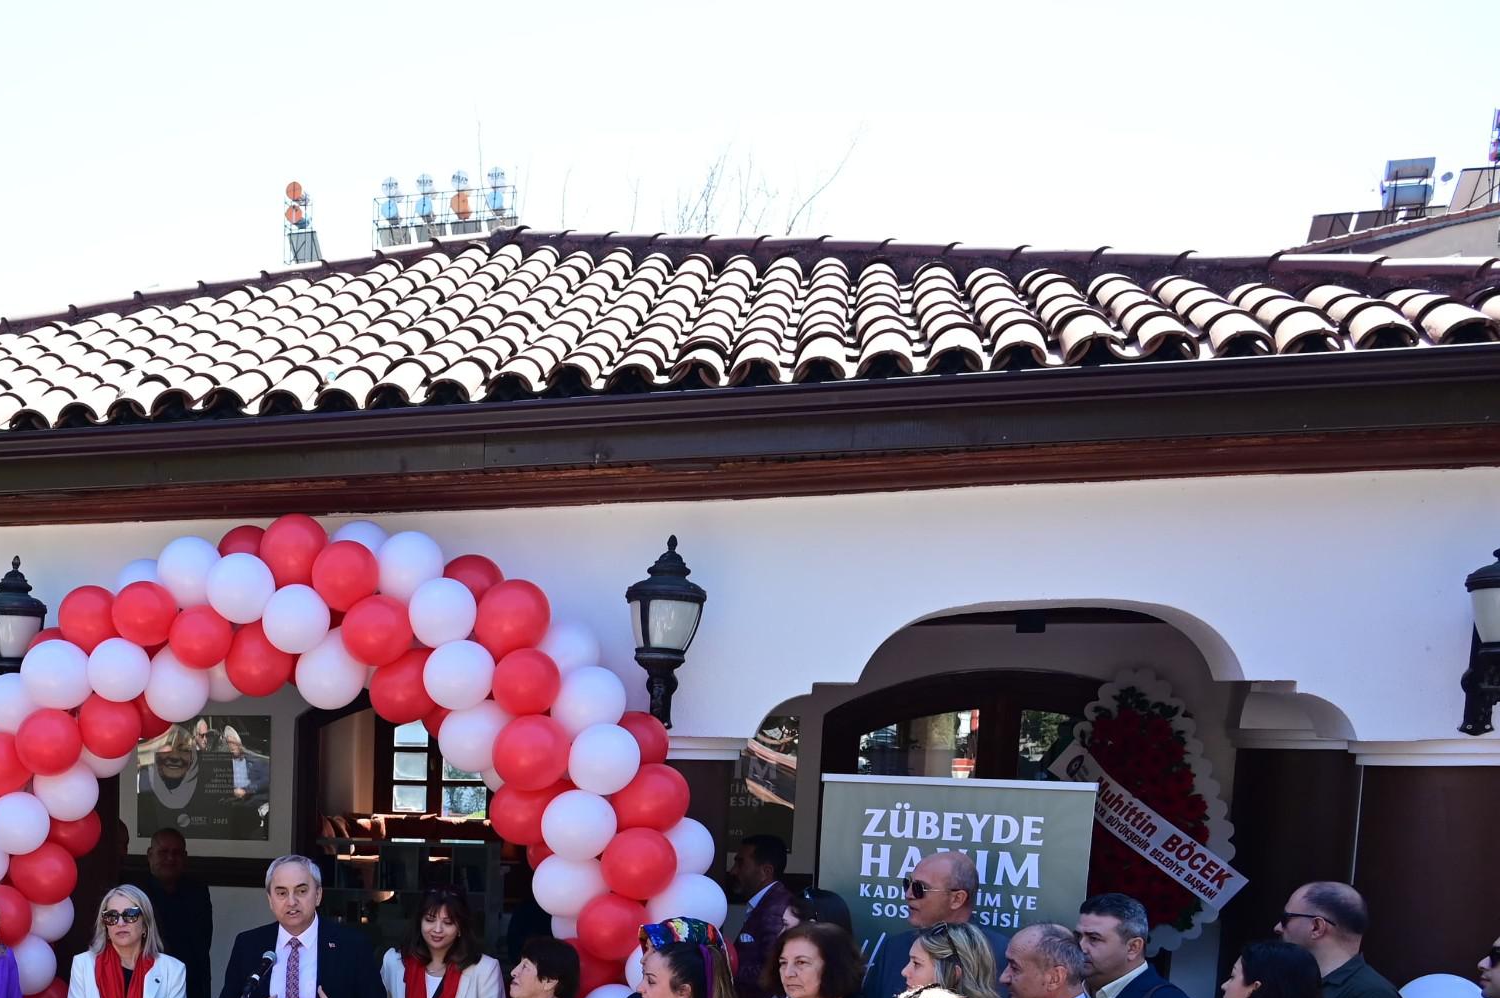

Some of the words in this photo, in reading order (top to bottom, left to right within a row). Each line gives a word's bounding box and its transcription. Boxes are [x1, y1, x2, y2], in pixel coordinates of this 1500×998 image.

[861, 802, 1045, 846] ZÜBEYDE
[859, 842, 1041, 889] HAIM
[1149, 848, 1186, 877] BELEDİYE
[1184, 874, 1218, 900] BAŞKANI
[1161, 833, 1235, 890] BÖCEK
[871, 902, 910, 919] SOS
[972, 908, 1020, 928] SİSİ
[1010, 894, 1037, 910] VE
